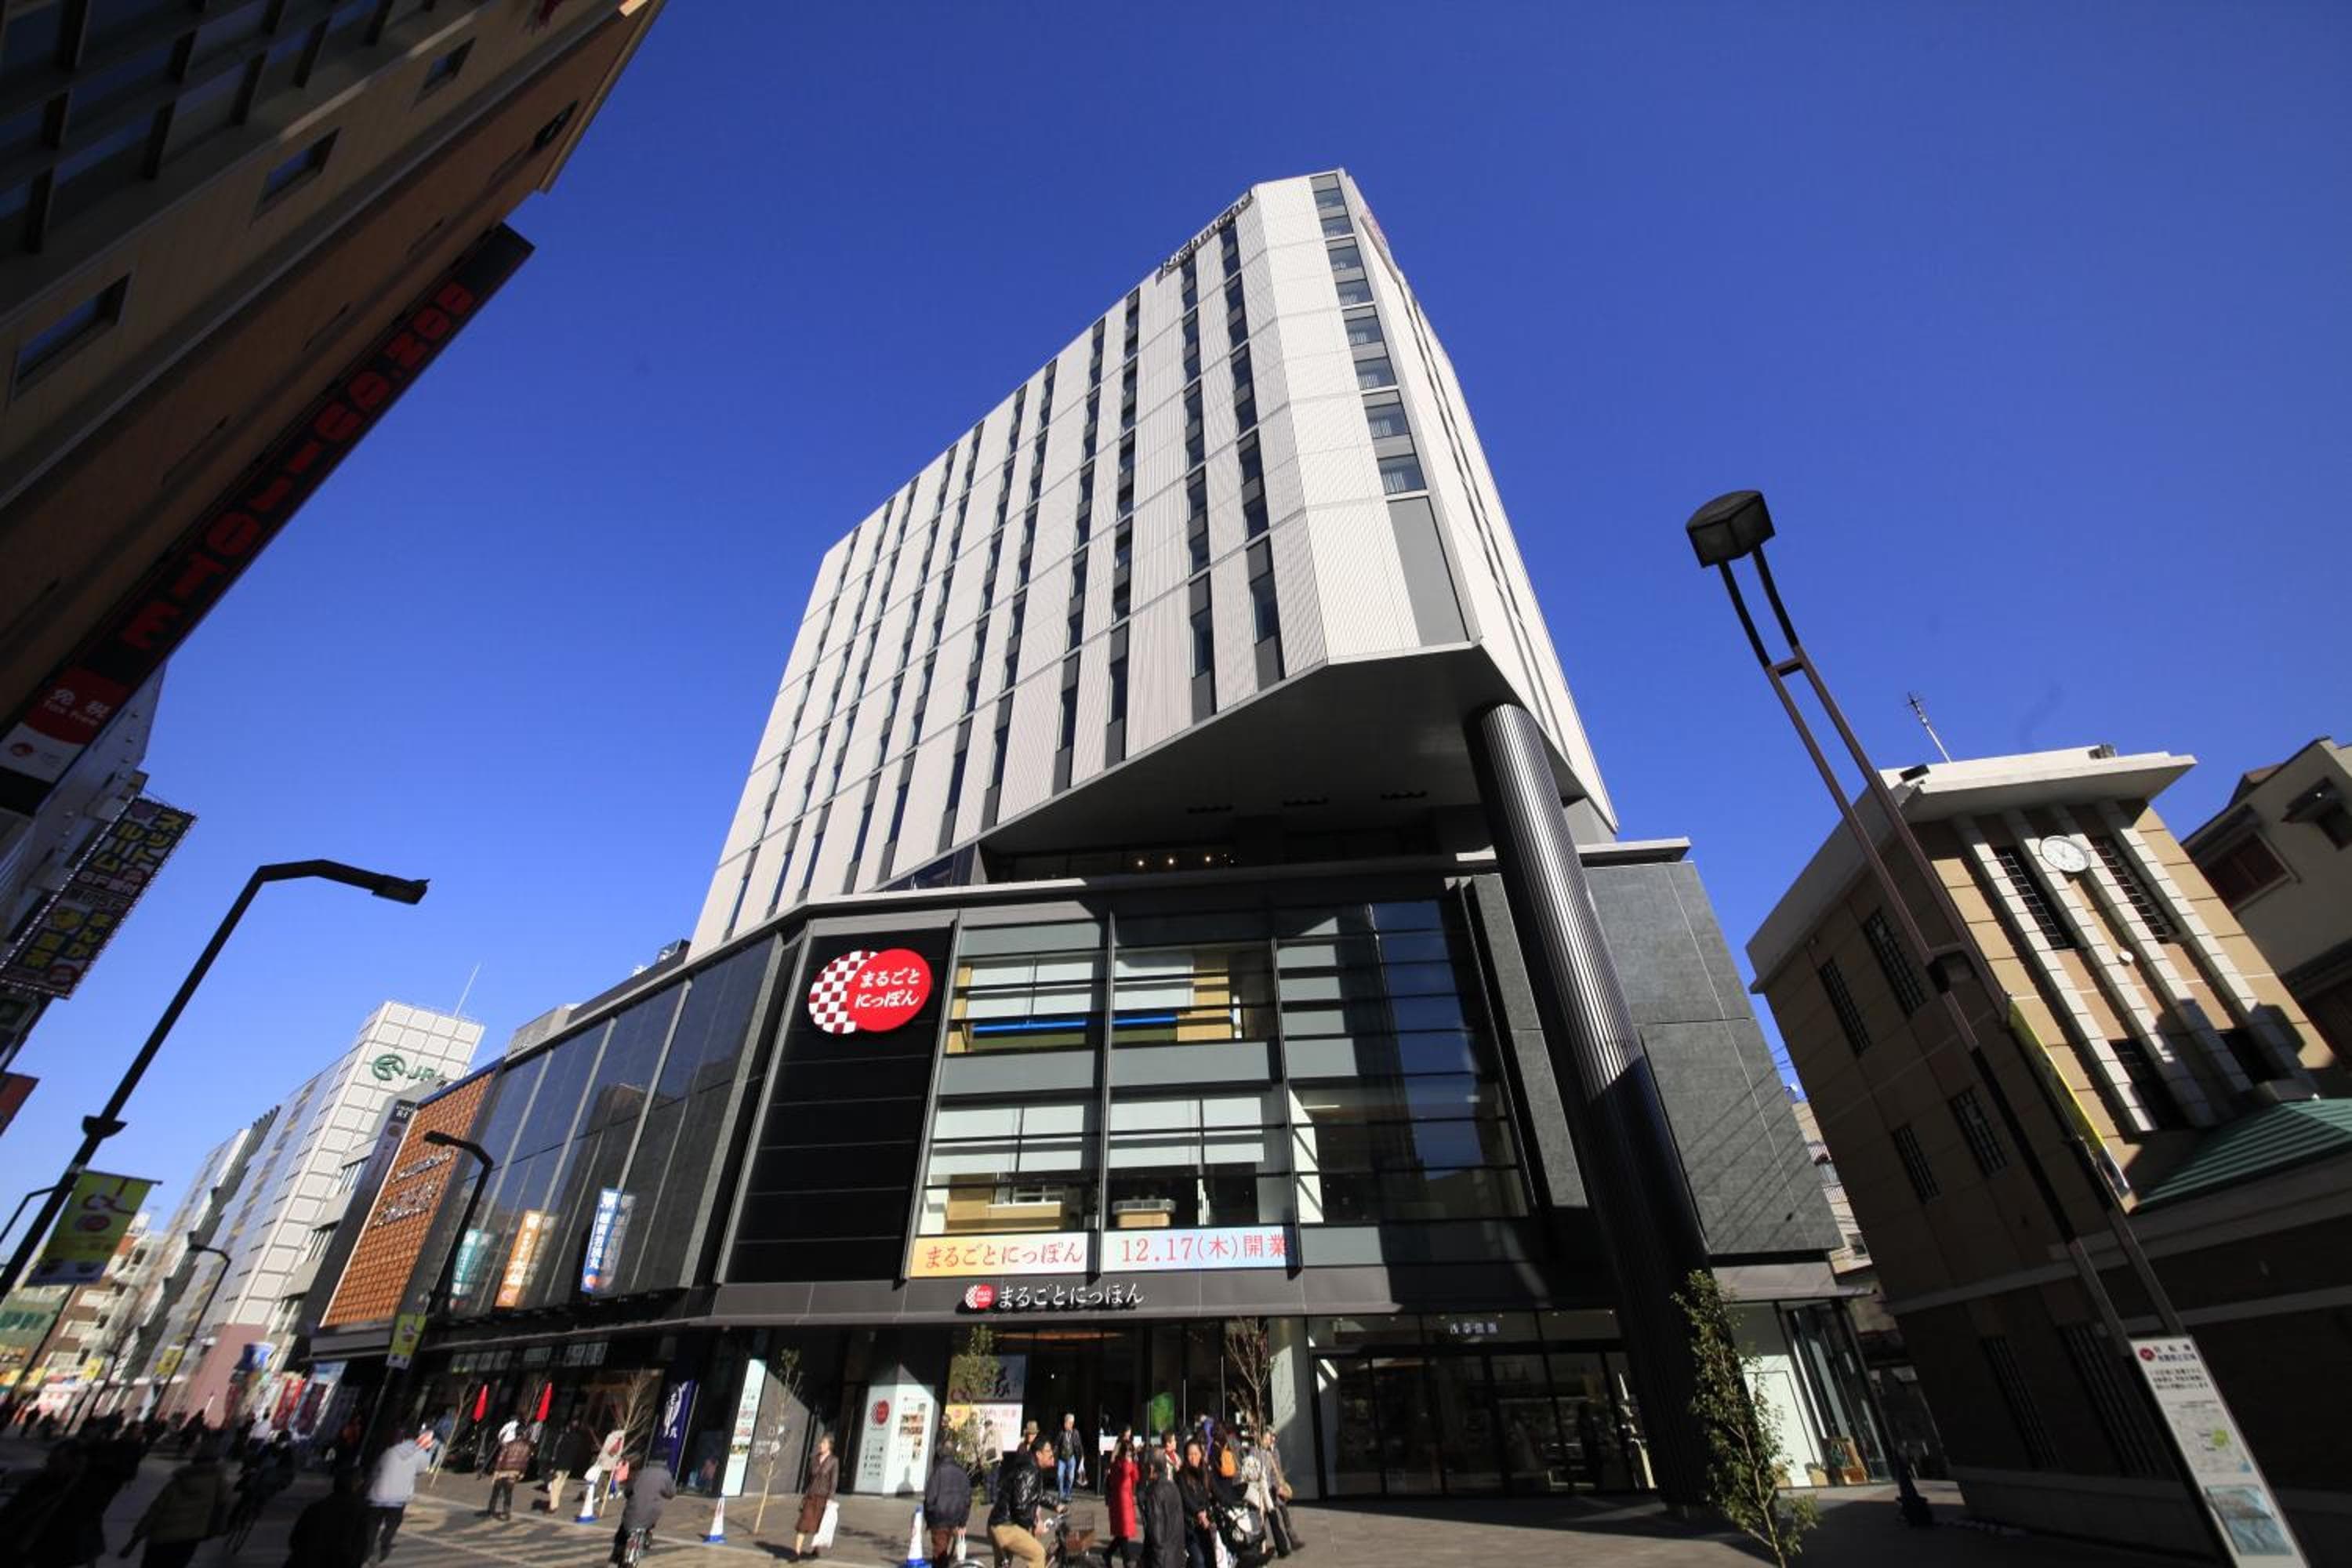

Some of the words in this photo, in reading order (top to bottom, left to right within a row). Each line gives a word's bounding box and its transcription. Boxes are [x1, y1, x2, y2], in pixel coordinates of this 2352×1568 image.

[860, 967, 921, 989] まるごと
[854, 989, 920, 1009] にっぽん
[925, 1241, 1083, 1269] まるごとにっぽん
